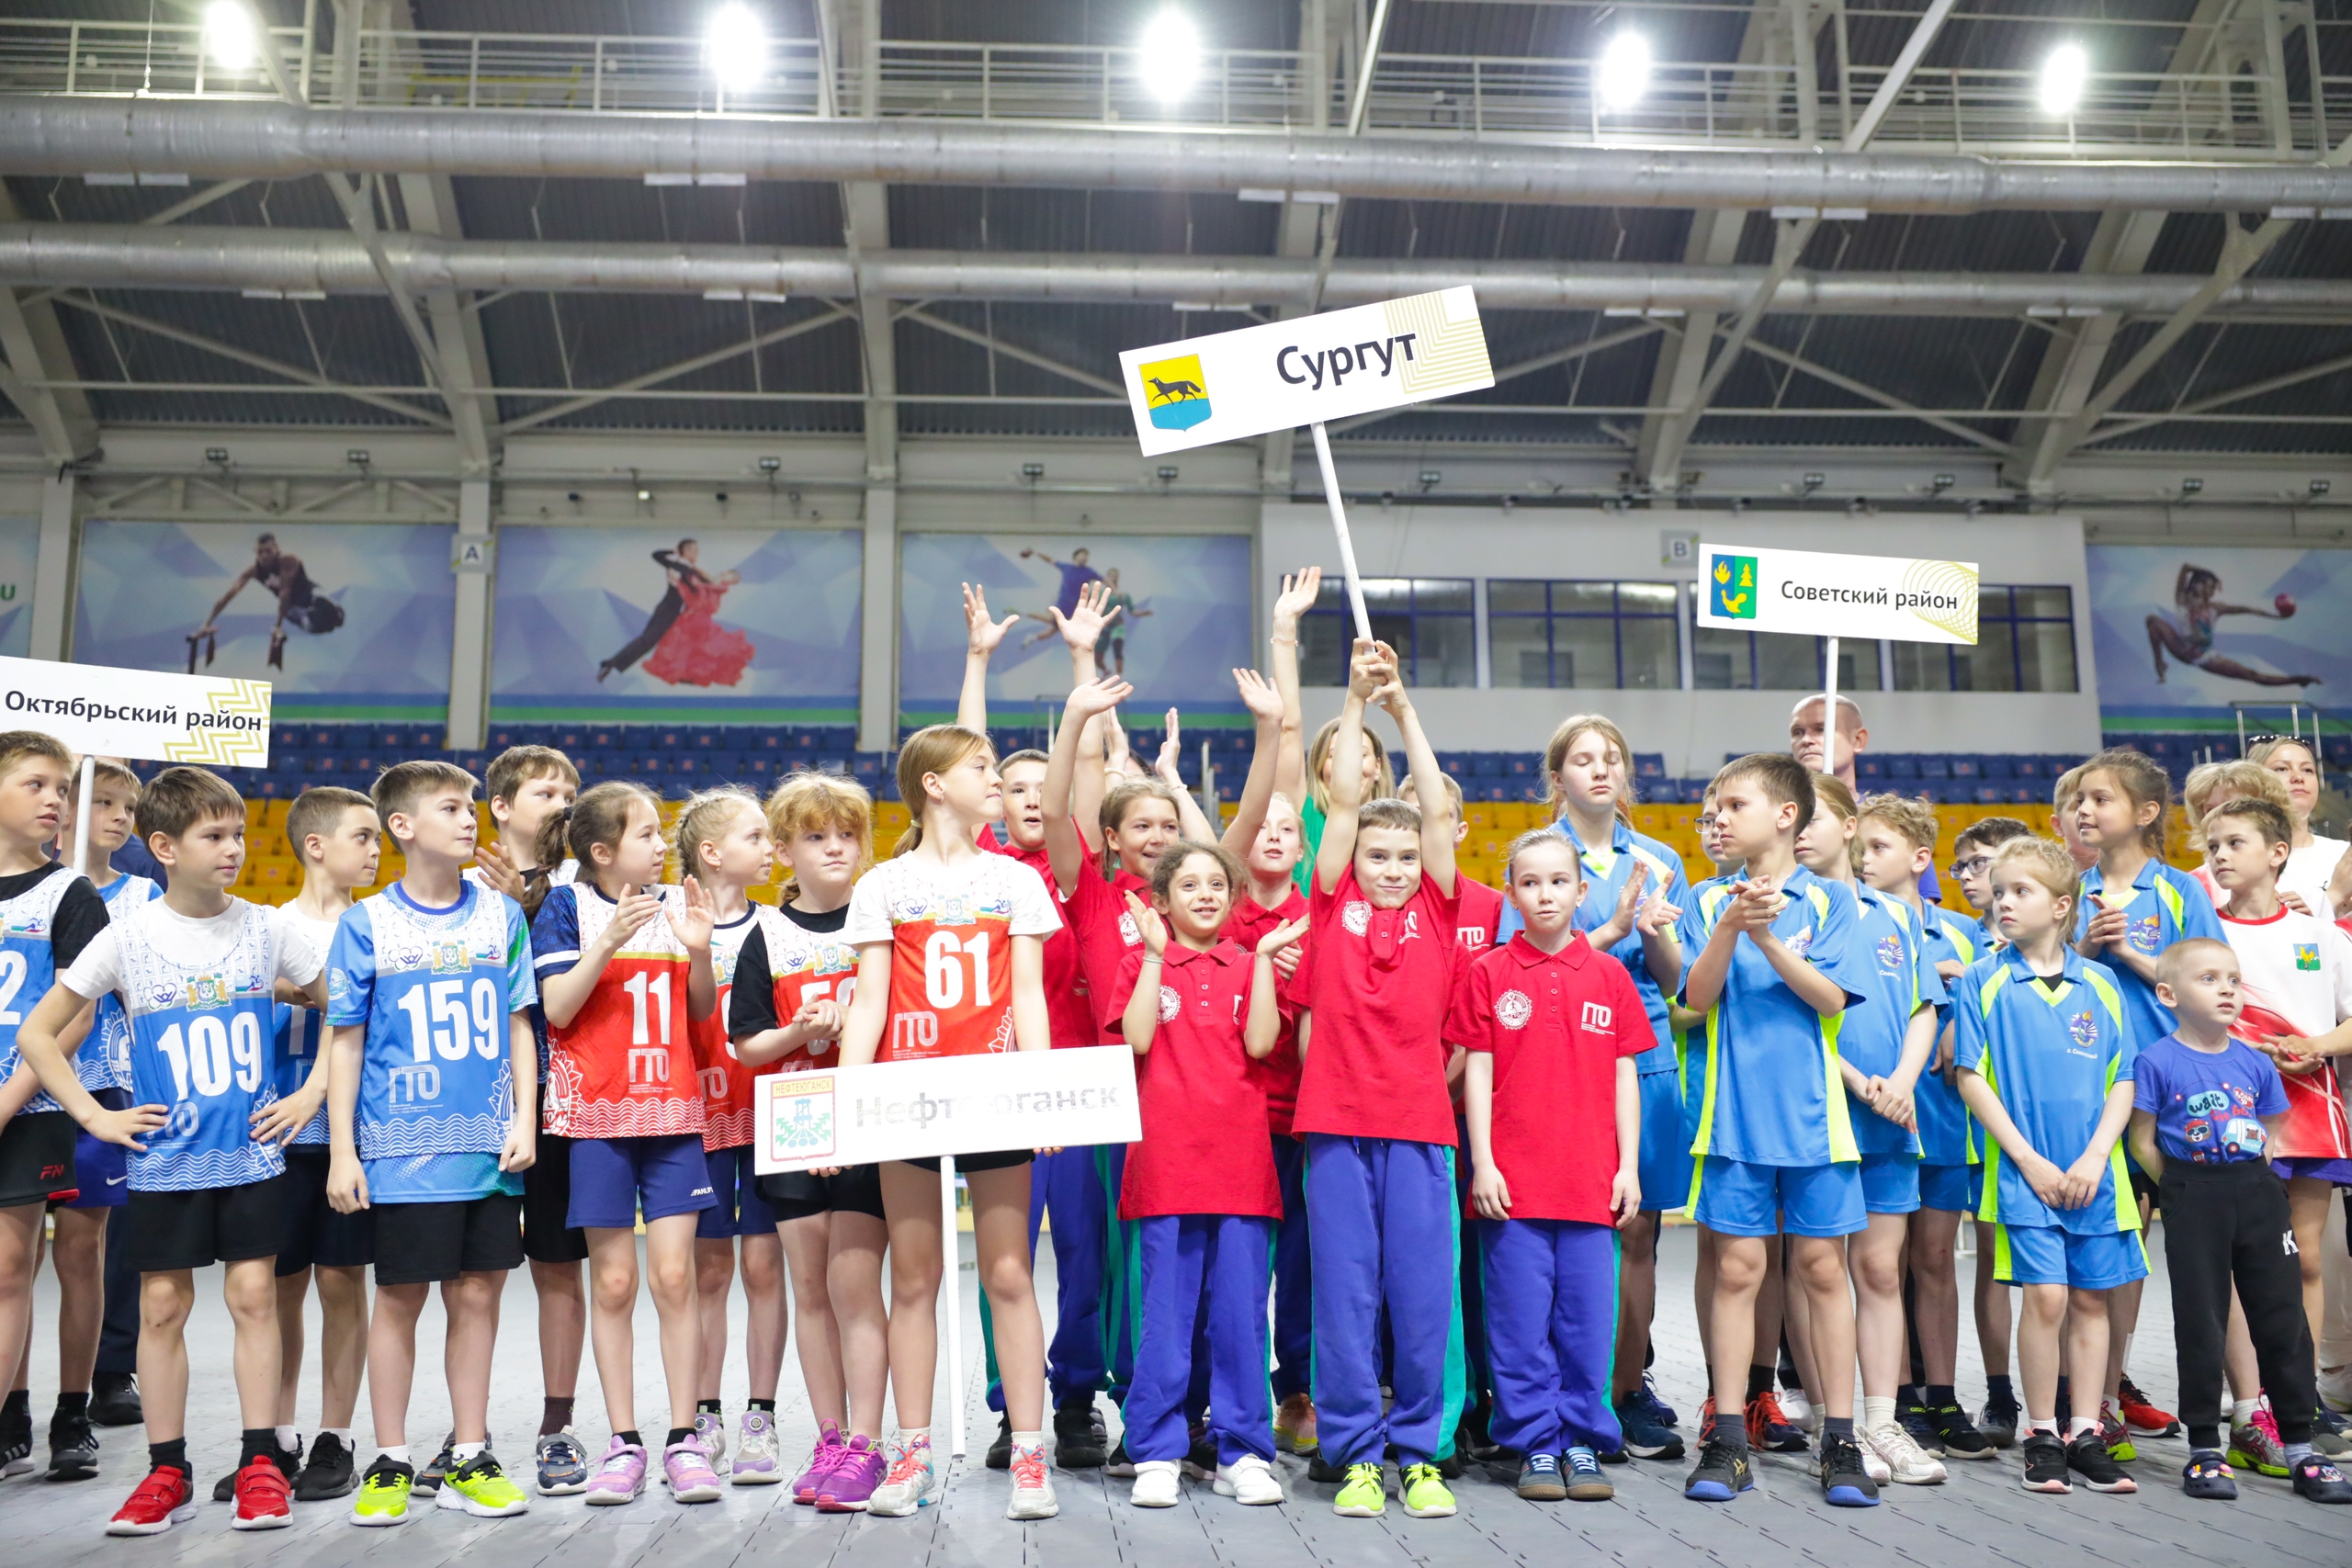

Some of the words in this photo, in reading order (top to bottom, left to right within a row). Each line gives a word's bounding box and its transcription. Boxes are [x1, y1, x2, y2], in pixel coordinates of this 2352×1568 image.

[1276, 333, 1417, 390] Сургут
[1781, 580, 1888, 605] Советский
[1894, 589, 1958, 611] район
[5, 690, 177, 725] Октябрьский
[186, 710, 262, 731] район
[924, 931, 992, 1009] 61
[397, 977, 500, 1063] 159
[623, 971, 672, 1045] 11
[1581, 1001, 1612, 1028] ГТО
[893, 1010, 938, 1049] ГТО
[156, 1011, 262, 1101] 109
[628, 1048, 670, 1083] ГТО
[388, 1064, 441, 1103] ГТО
[695, 1066, 729, 1102] ТО
[775, 1079, 831, 1095] НЕФТЕЮГАНСК
[2189, 1093, 2224, 1113] wait
[147, 1101, 199, 1139] ТО
